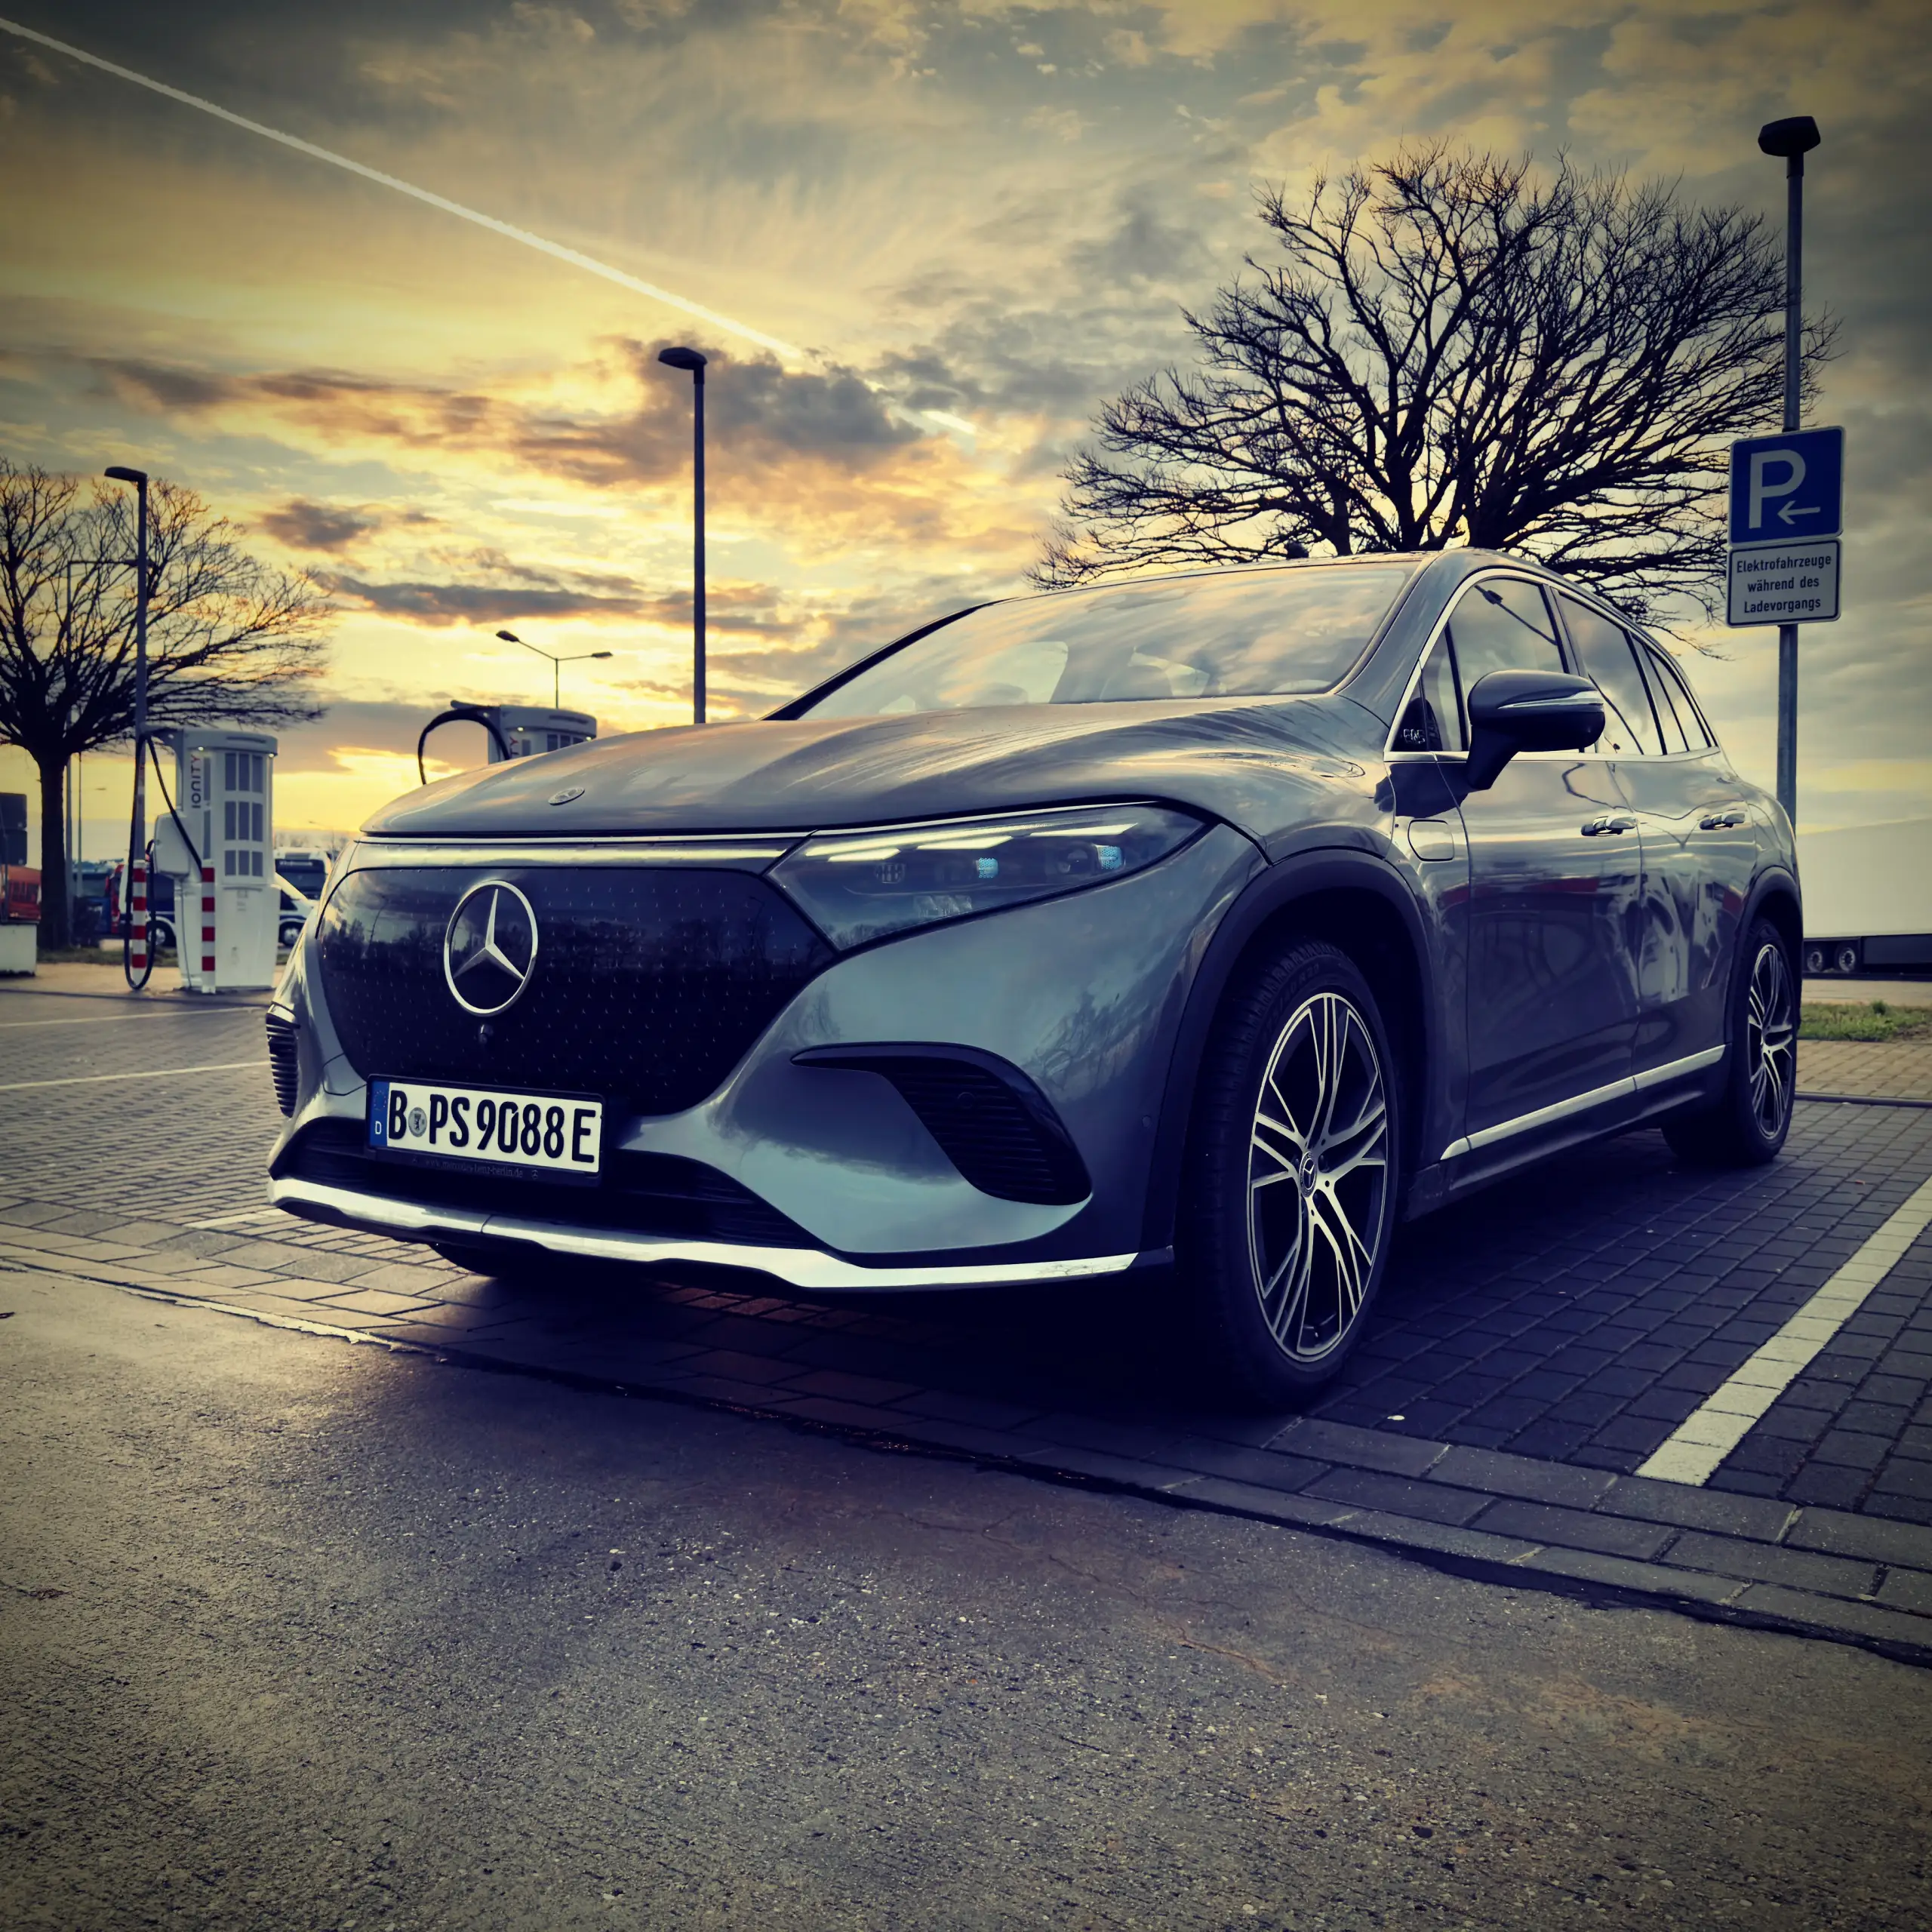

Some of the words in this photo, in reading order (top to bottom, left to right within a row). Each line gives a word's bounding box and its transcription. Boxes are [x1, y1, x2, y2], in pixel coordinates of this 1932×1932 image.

[1749, 449, 1806, 529] P
[1737, 555, 1832, 573] Elektrofahrzeuge
[1747, 577, 1795, 592] während
[1800, 576, 1820, 589] des
[1744, 598, 1821, 614] Ladevorgangs
[191, 754, 201, 809] IONITY
[388, 1090, 408, 1140] B
[375, 1121, 382, 1135] D
